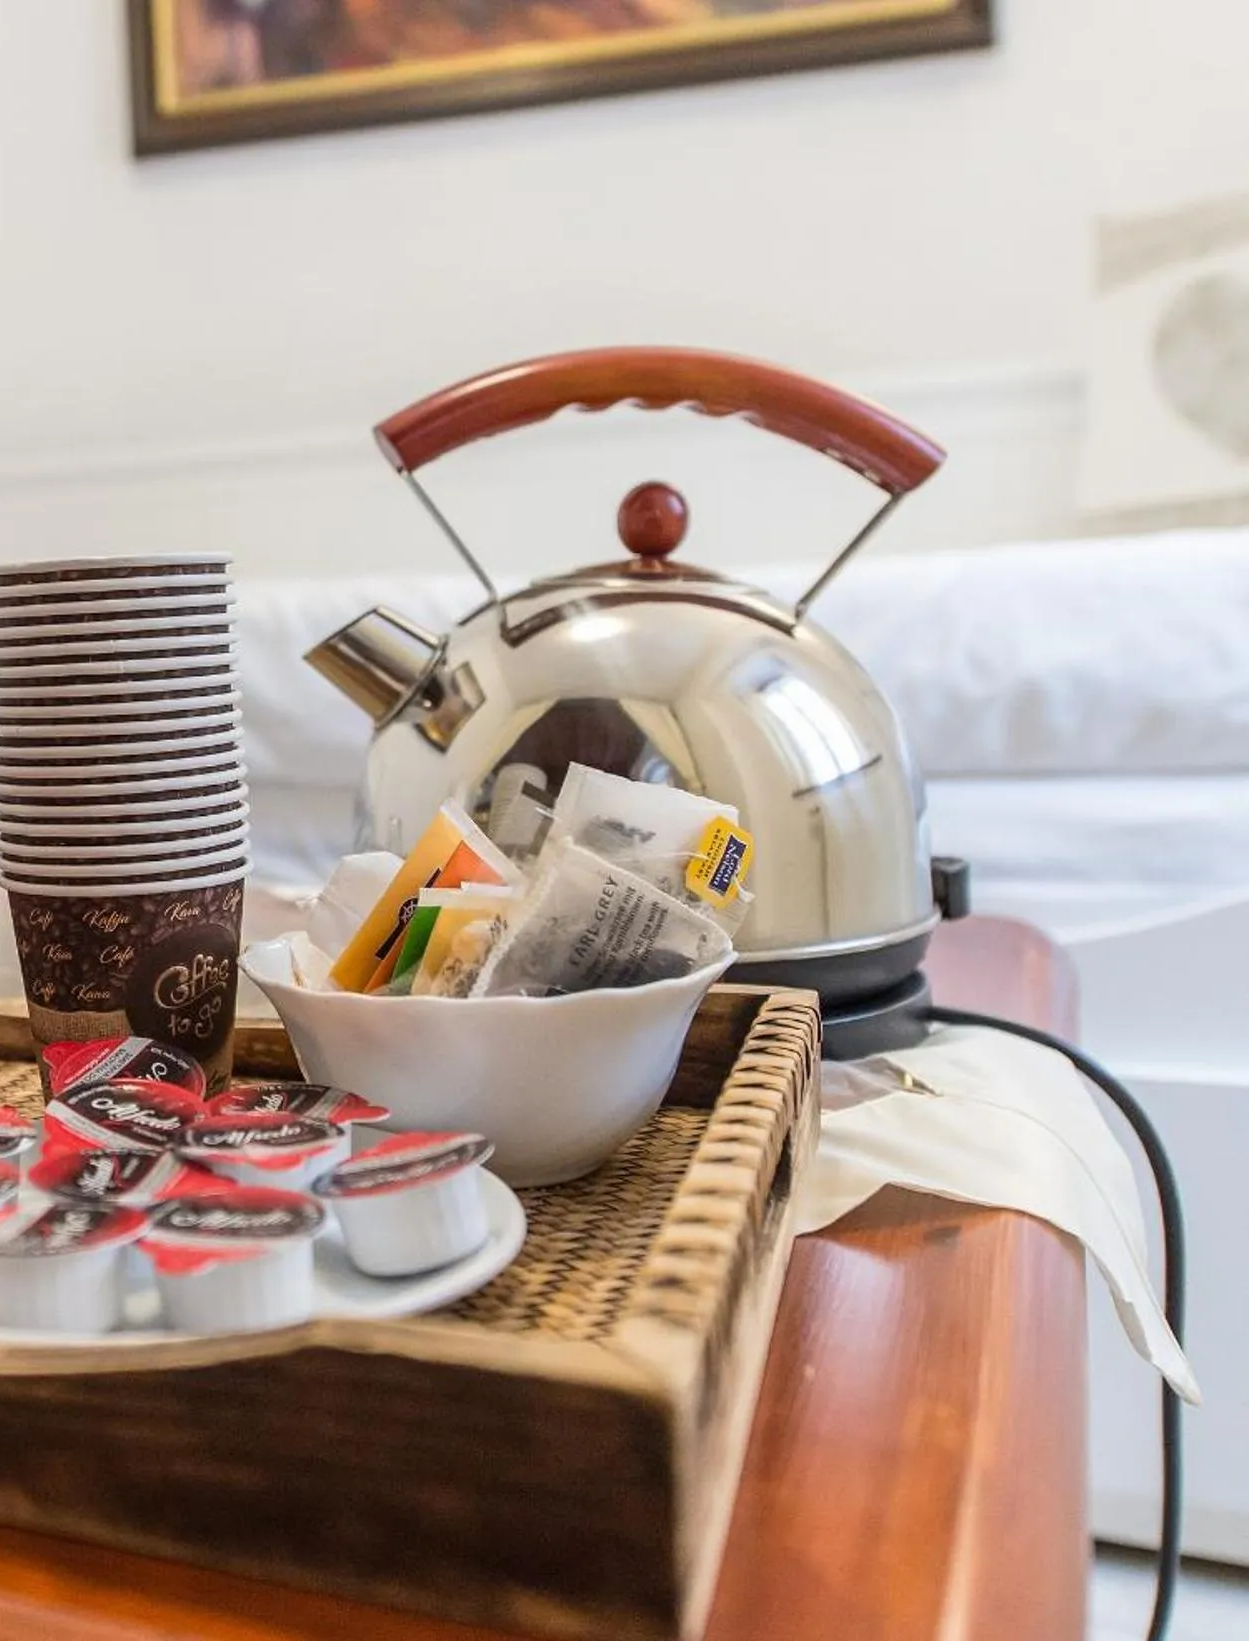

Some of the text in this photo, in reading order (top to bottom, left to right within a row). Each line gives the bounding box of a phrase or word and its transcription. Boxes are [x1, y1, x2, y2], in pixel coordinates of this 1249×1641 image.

[569, 925, 600, 967] EARL
[595, 875, 619, 921] GREY
[168, 996, 222, 1039] to go
[91, 1097, 181, 1131] Alfredo
[203, 1124, 304, 1147] Alfredo
